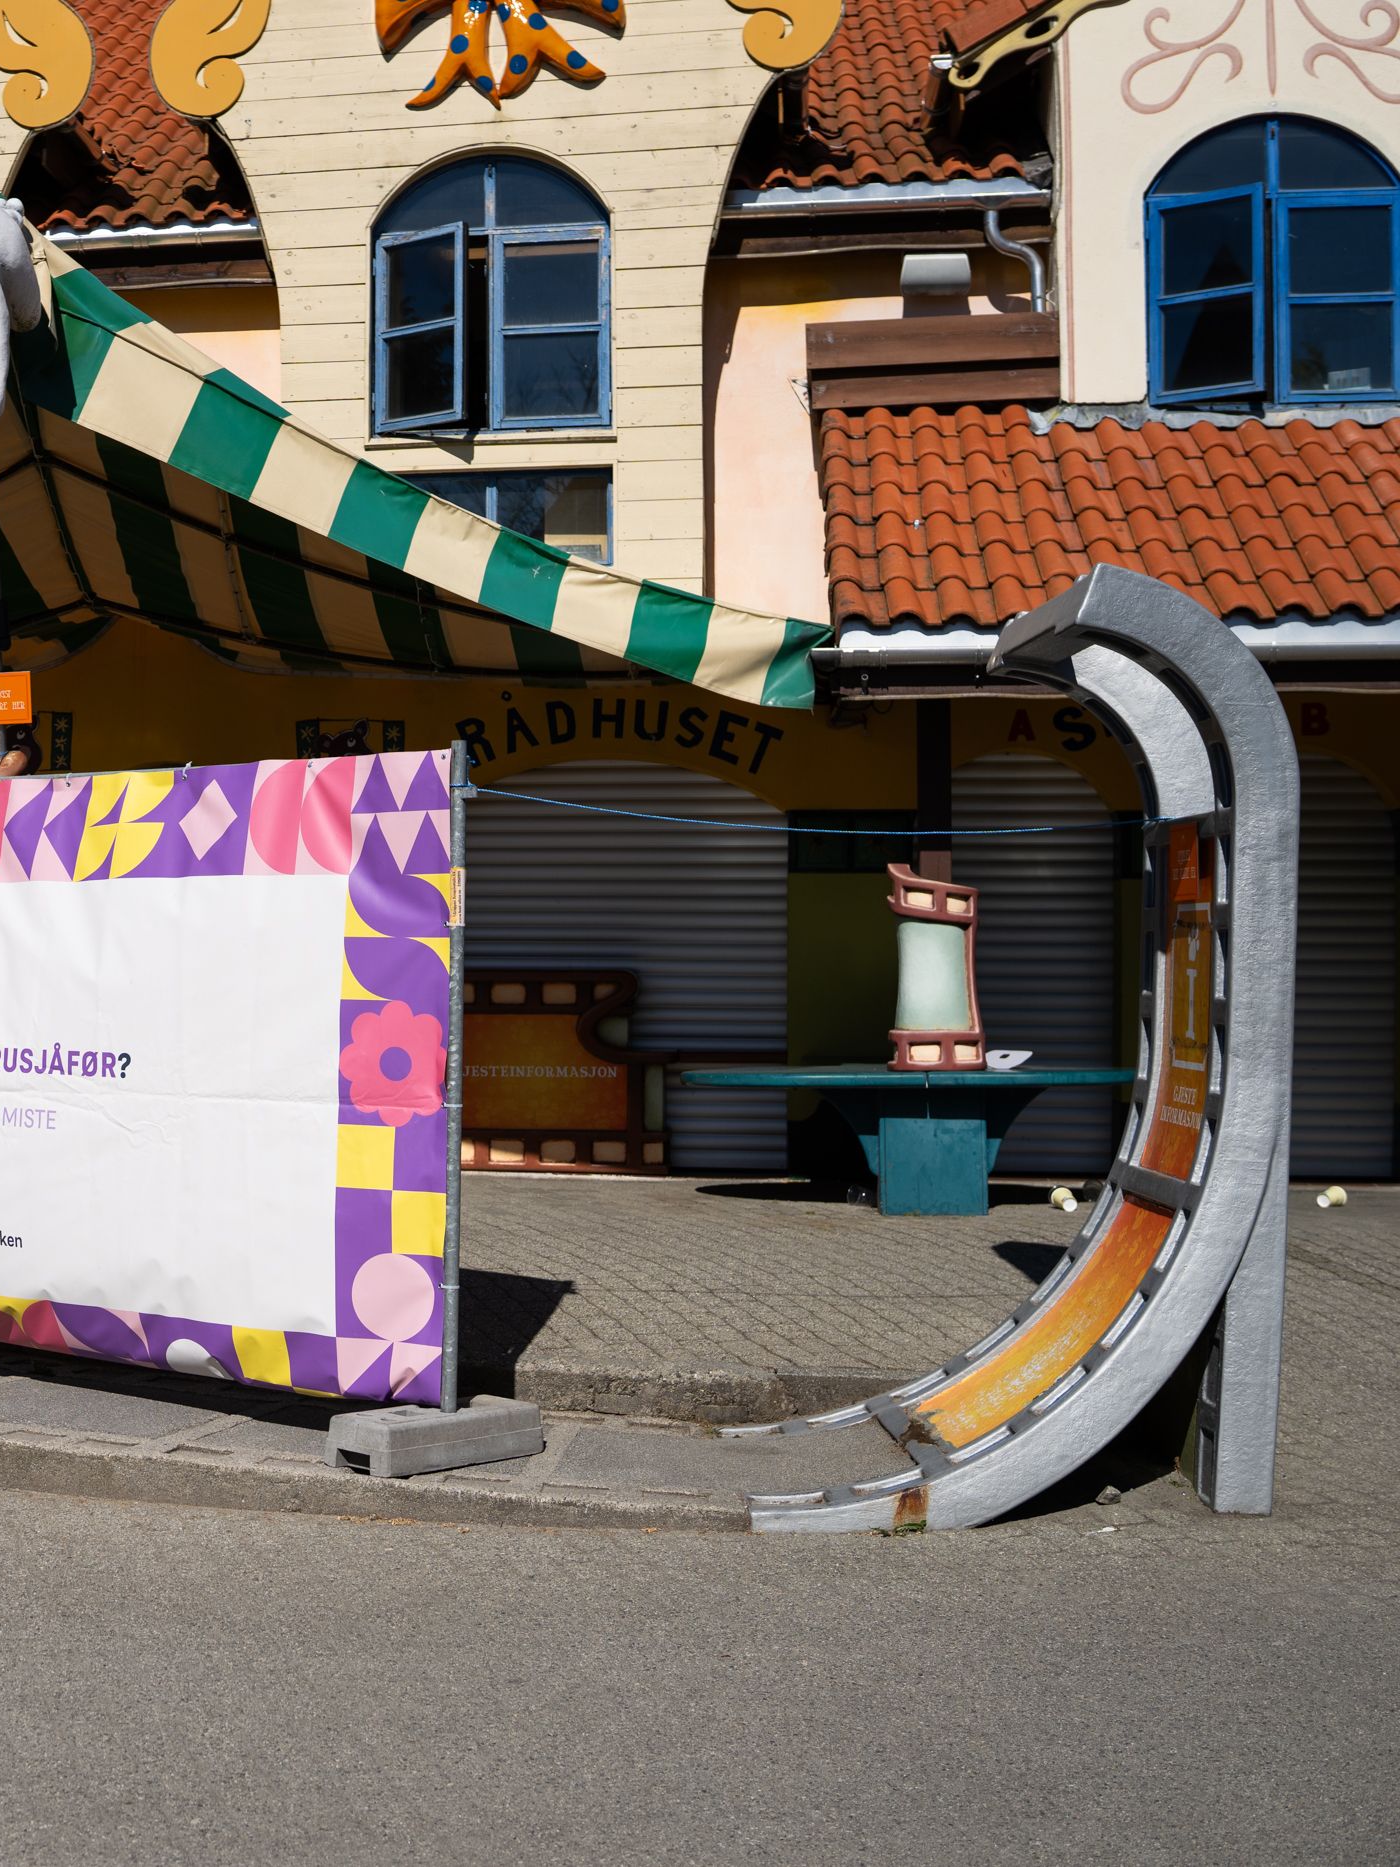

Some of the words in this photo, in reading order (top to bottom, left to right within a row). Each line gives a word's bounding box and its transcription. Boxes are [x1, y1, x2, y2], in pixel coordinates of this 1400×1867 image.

[12, 701, 25, 710] HER
[1301, 703, 1330, 736] B
[455, 690, 785, 775] RÅDHUSET
[1008, 709, 1036, 742] A
[1053, 706, 1111, 752] S
[462, 1064, 618, 1079] JESTEINFORMASJON
[2, 1107, 57, 1130] MISTE
